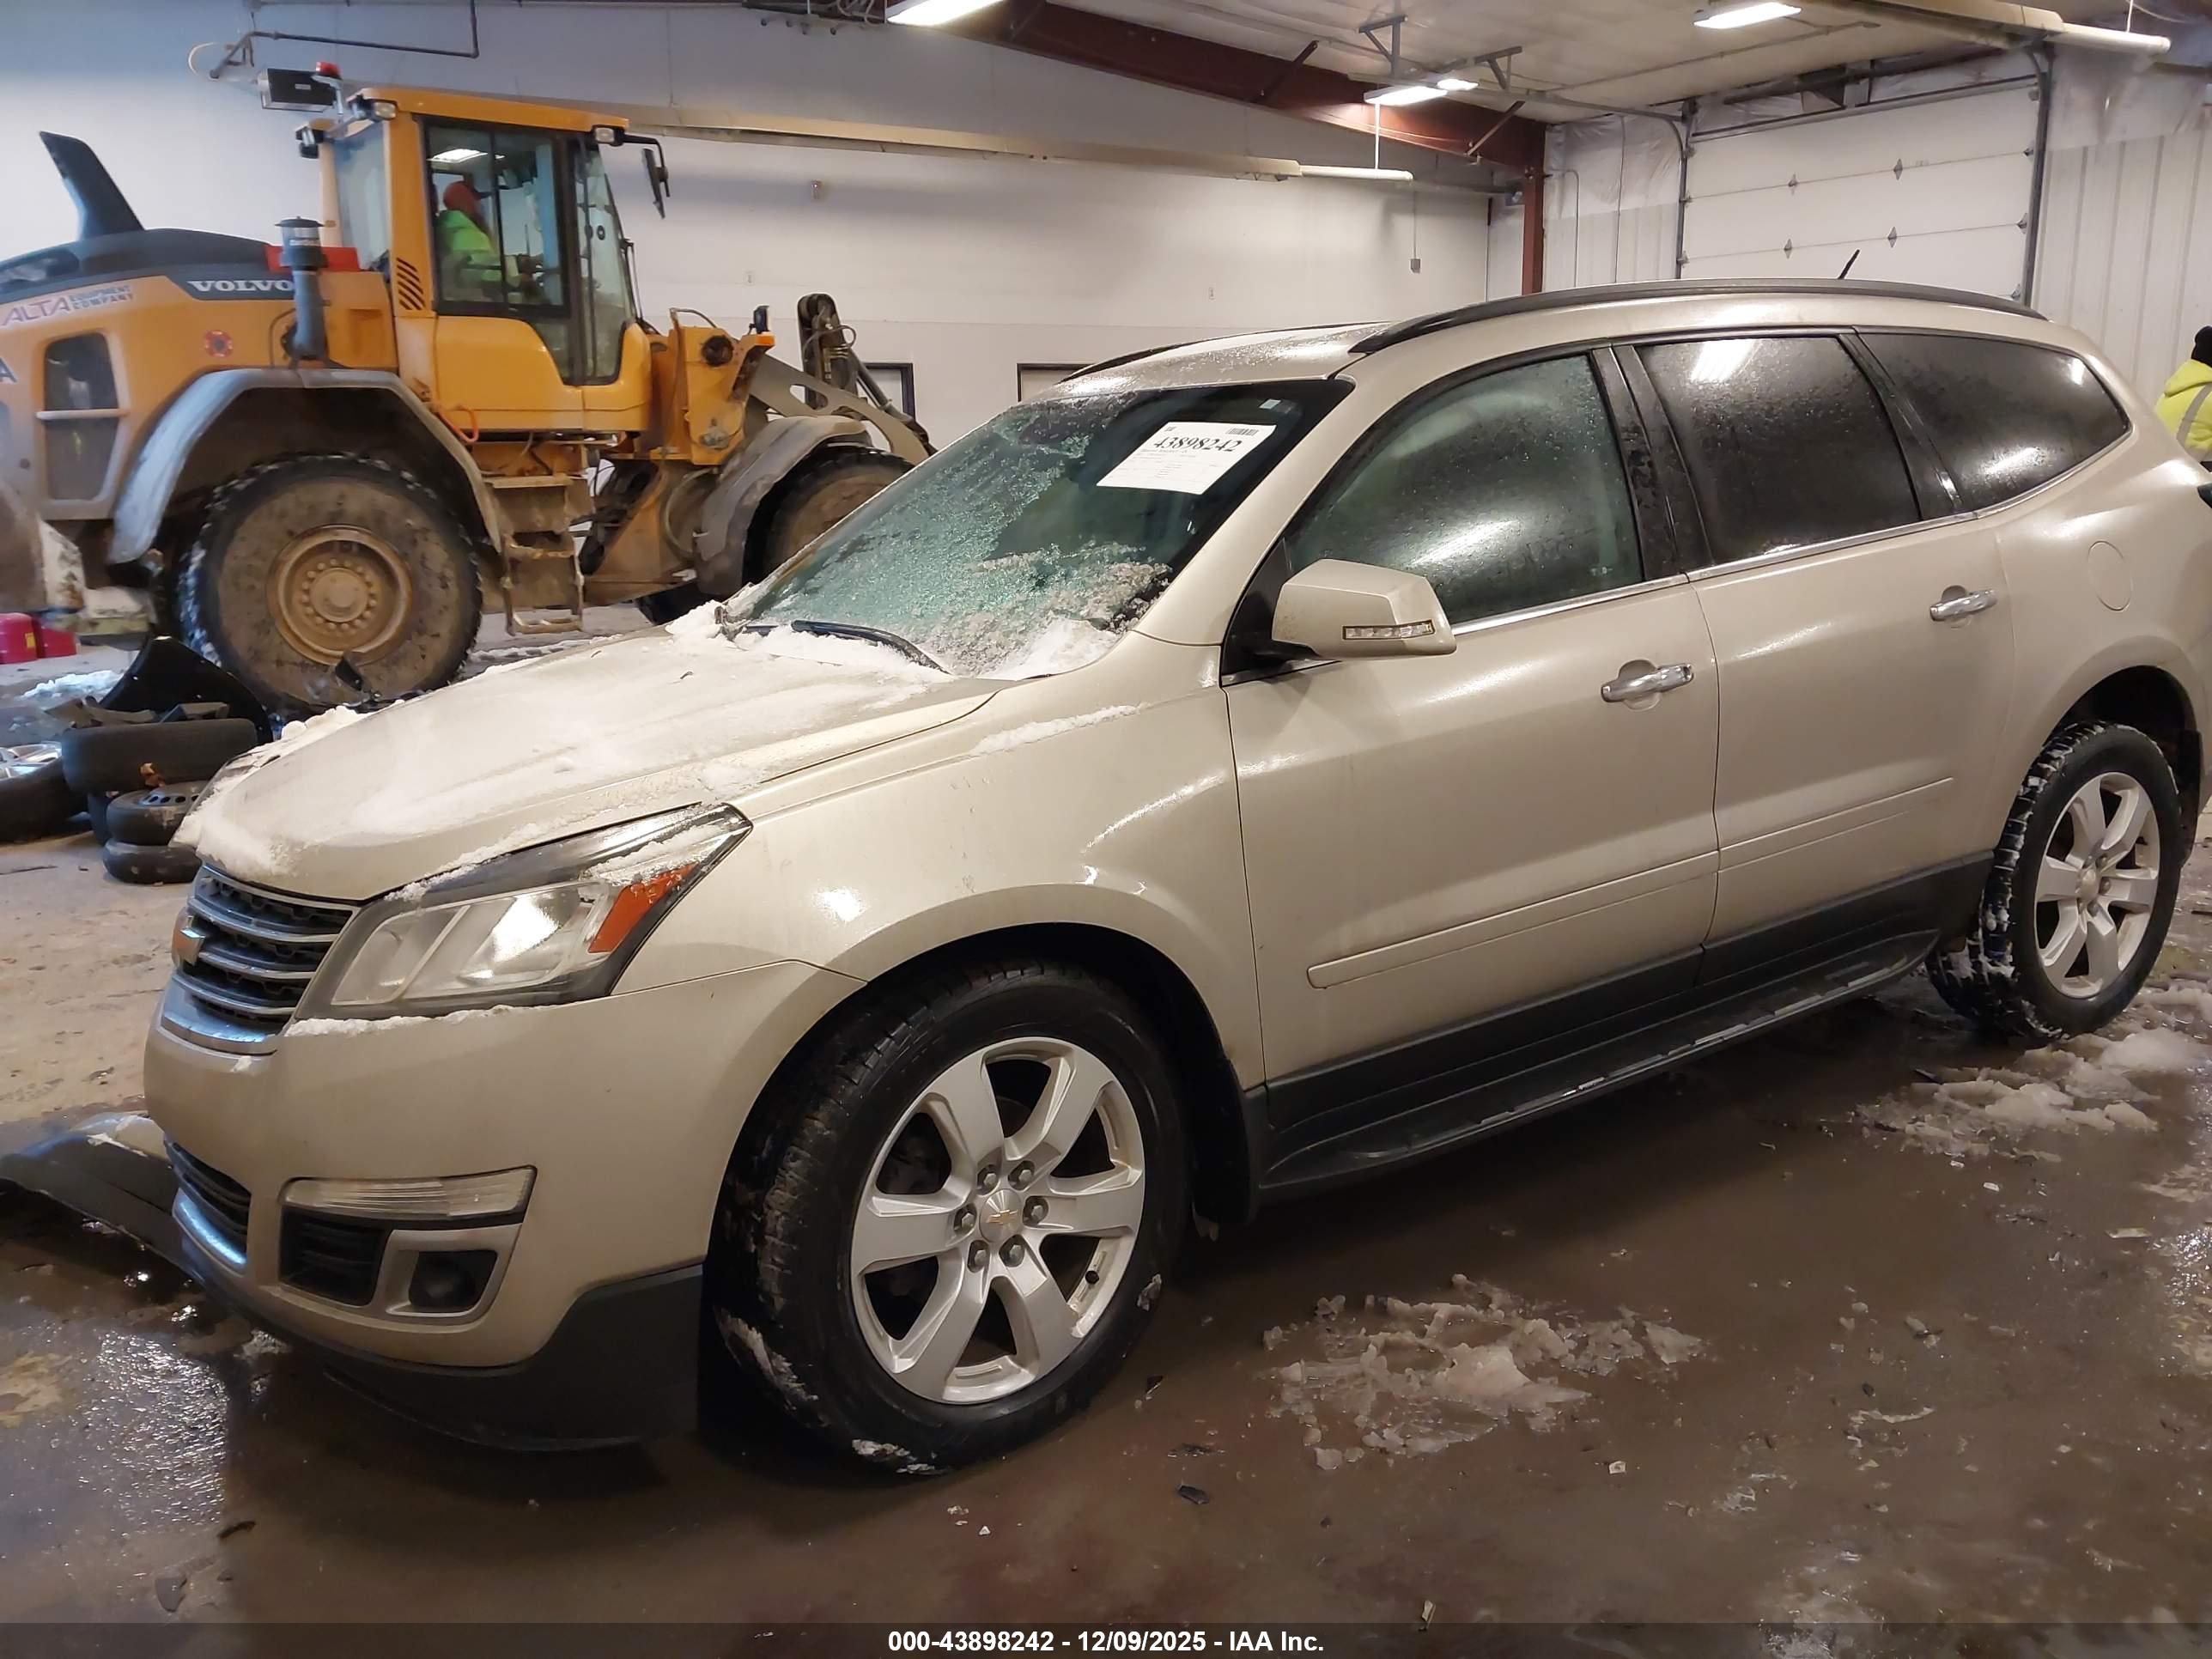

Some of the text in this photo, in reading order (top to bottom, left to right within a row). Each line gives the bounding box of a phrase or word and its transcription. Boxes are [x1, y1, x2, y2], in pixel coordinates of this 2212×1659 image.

[186, 279, 295, 292] VOLVO
[73, 292, 134, 310] COMPANY
[2, 296, 71, 326] ALTA
[1153, 436, 1243, 453] 43898242
